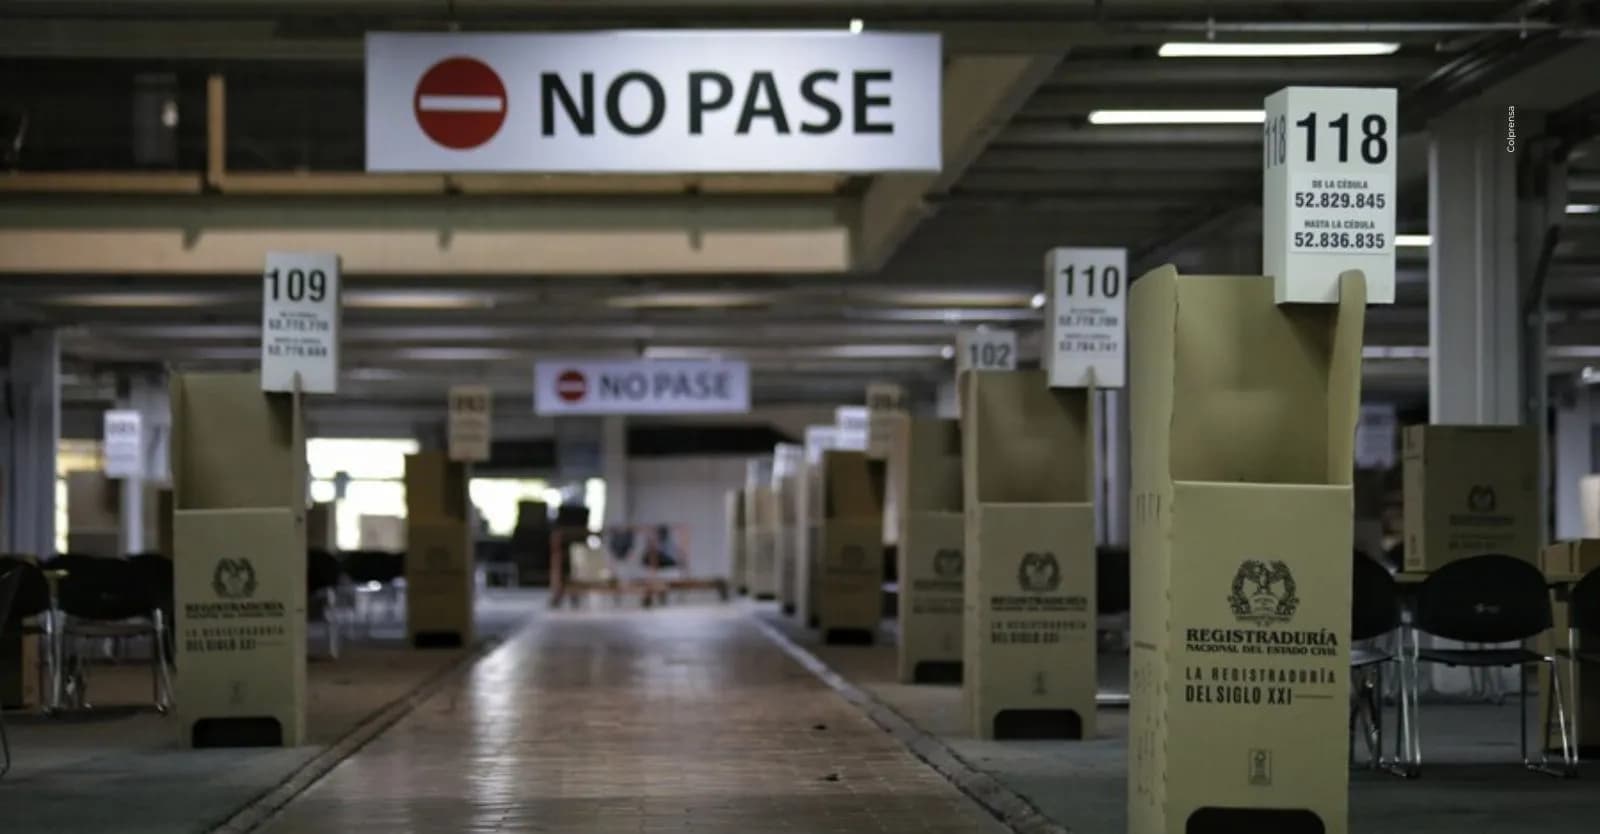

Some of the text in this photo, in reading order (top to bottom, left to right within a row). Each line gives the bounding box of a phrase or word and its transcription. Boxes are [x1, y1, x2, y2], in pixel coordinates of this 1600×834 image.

[540, 70, 895, 136] NO PASE
[1296, 112, 1388, 165] 118
[1312, 178, 1368, 190] DE LA CÉDULA
[1295, 192, 1386, 209] 52.829.845
[1304, 218, 1375, 230] HASTA LA CÉDULA
[1294, 231, 1385, 249] 52.836.835
[264, 267, 326, 303] 109
[1060, 264, 1119, 299] 110
[968, 343, 1010, 367] 102
[599, 369, 731, 400] NO PASE
[1186, 628, 1338, 645] REGISTRADURÍA
[1186, 643, 1338, 657] NACIONAL DEL ESTADO CIVIL
[1185, 666, 1336, 684] LA REGISTRADURÍA
[1185, 685, 1292, 705] DEL SIGLO XXI
